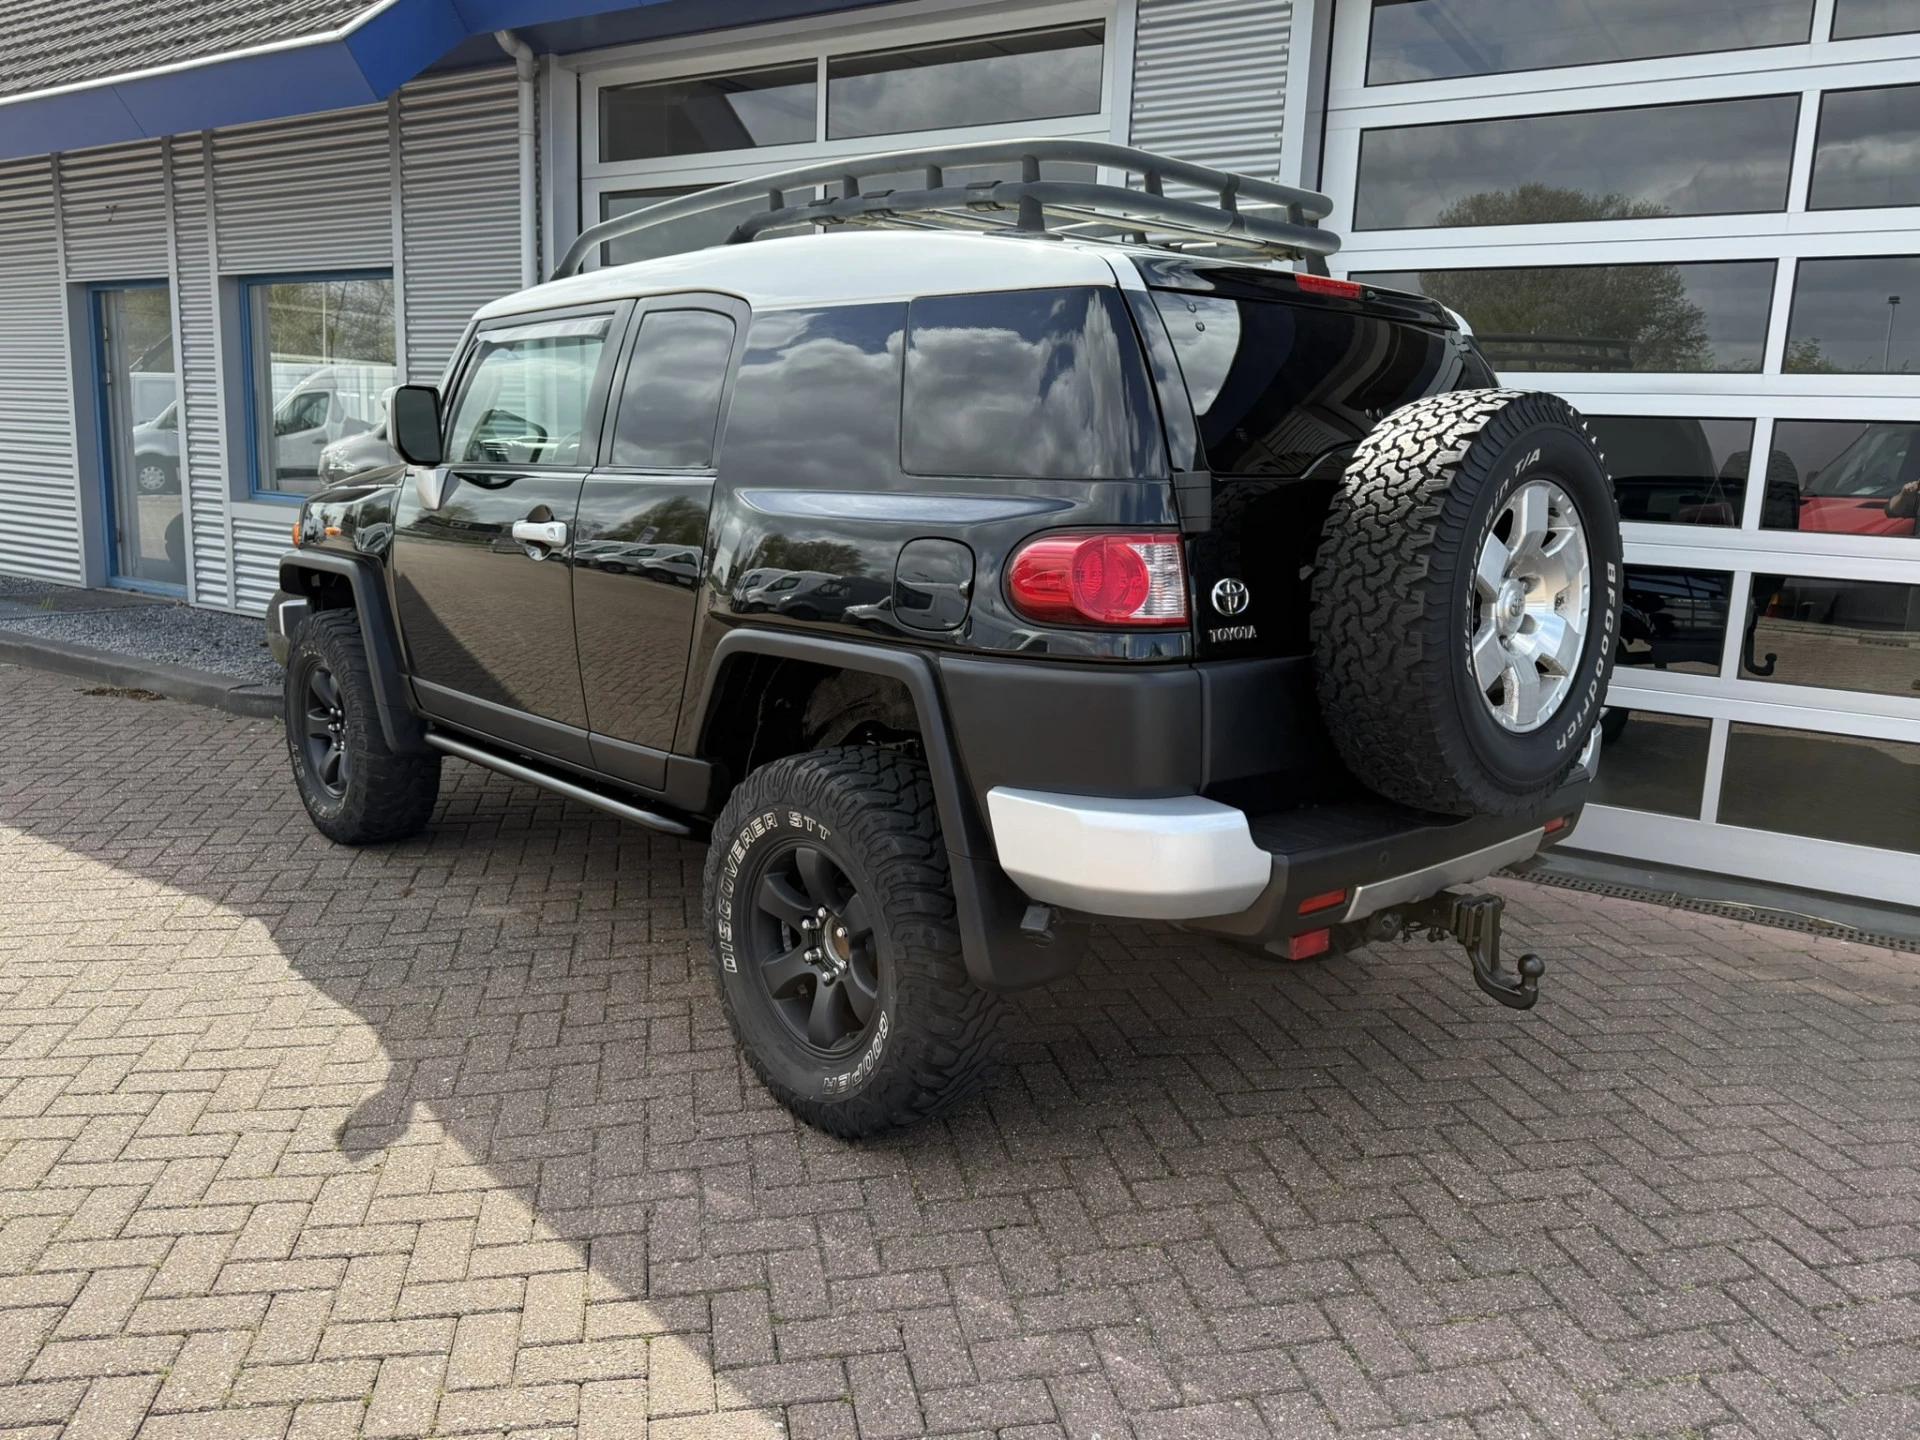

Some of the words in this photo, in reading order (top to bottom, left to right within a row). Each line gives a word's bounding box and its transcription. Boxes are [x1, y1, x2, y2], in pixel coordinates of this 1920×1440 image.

[1514, 447, 1541, 475] T/A
[1208, 625, 1257, 643] TOYOTA
[717, 812, 778, 973] DISCOVERER
[788, 811, 832, 840] STT
[822, 1010, 889, 1095] COOPER
